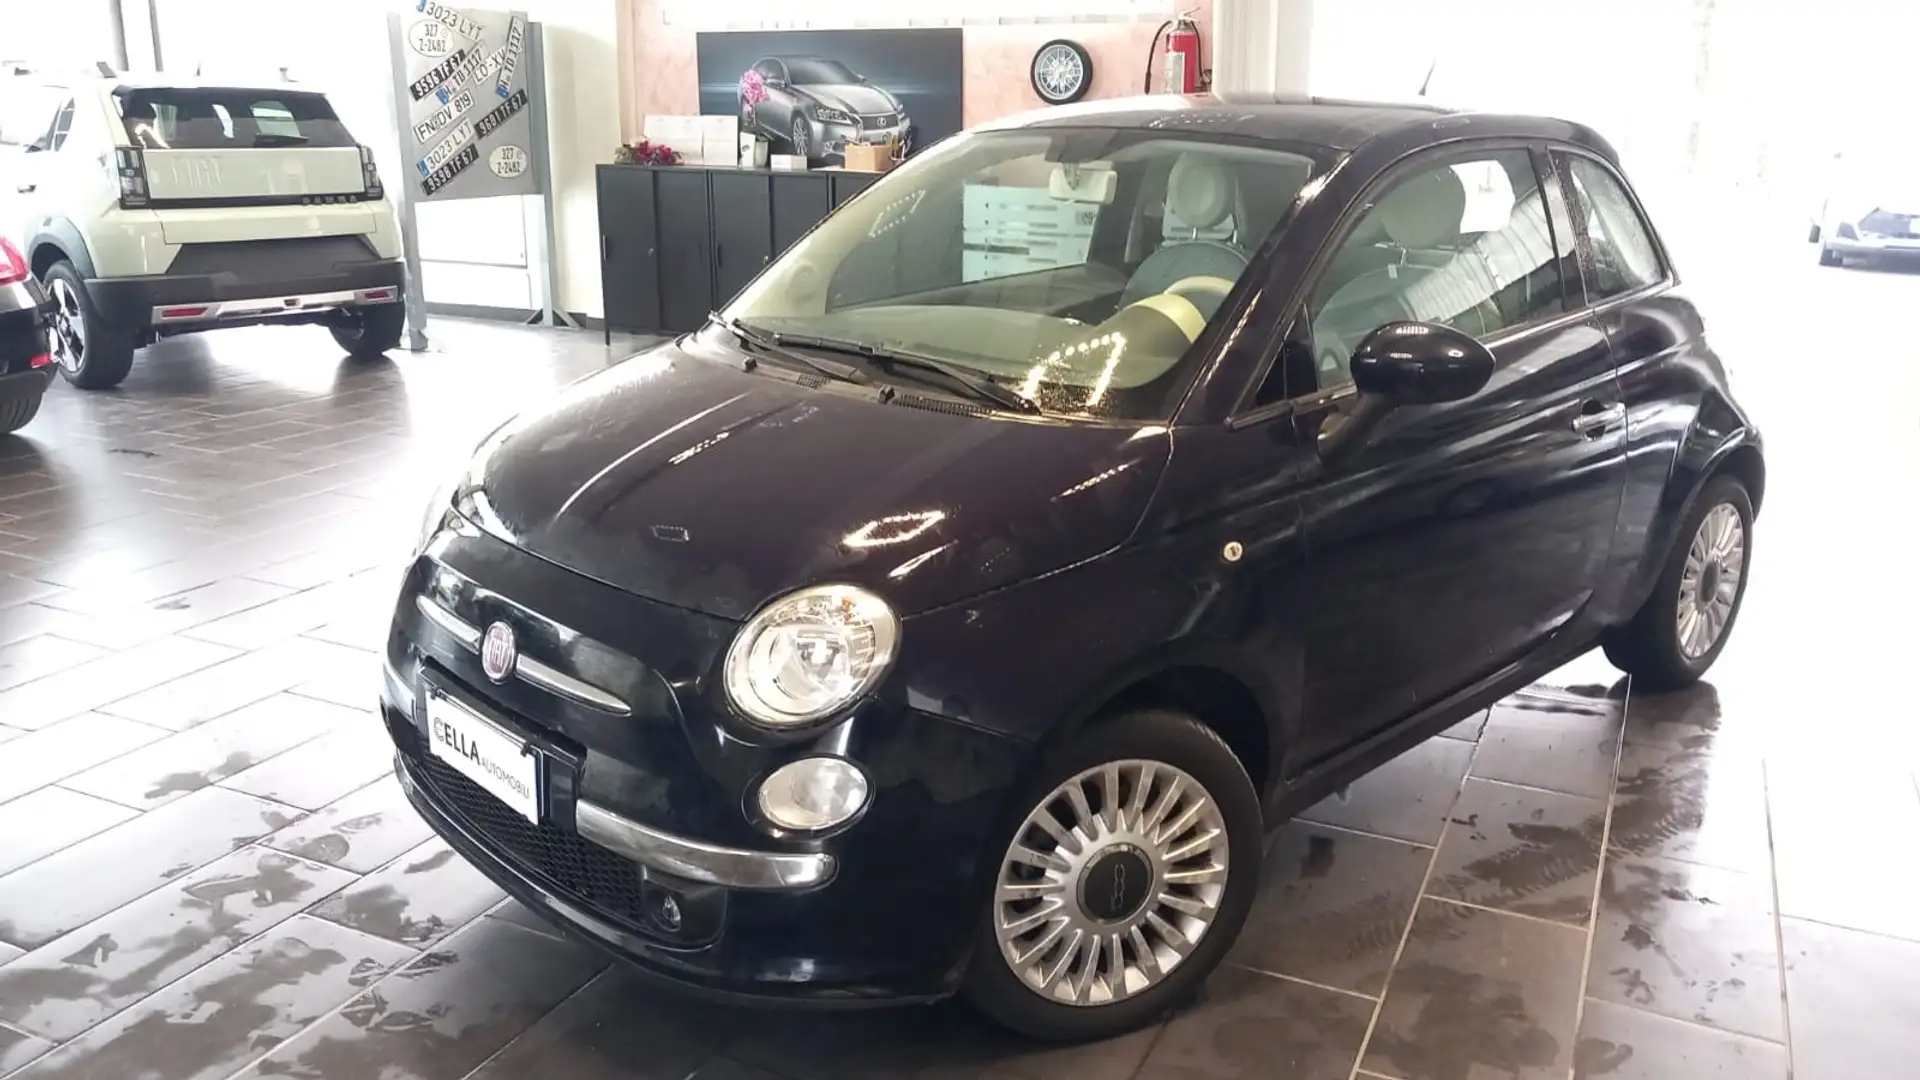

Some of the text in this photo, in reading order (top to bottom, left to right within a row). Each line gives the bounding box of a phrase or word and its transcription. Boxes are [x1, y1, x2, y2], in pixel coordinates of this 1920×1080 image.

[426, 2, 483, 40] 3023 LYT
[418, 119, 435, 140] FN
[454, 93, 471, 113] 819
[427, 120, 474, 169] 3023 LYT
[433, 716, 481, 767] CELLA
